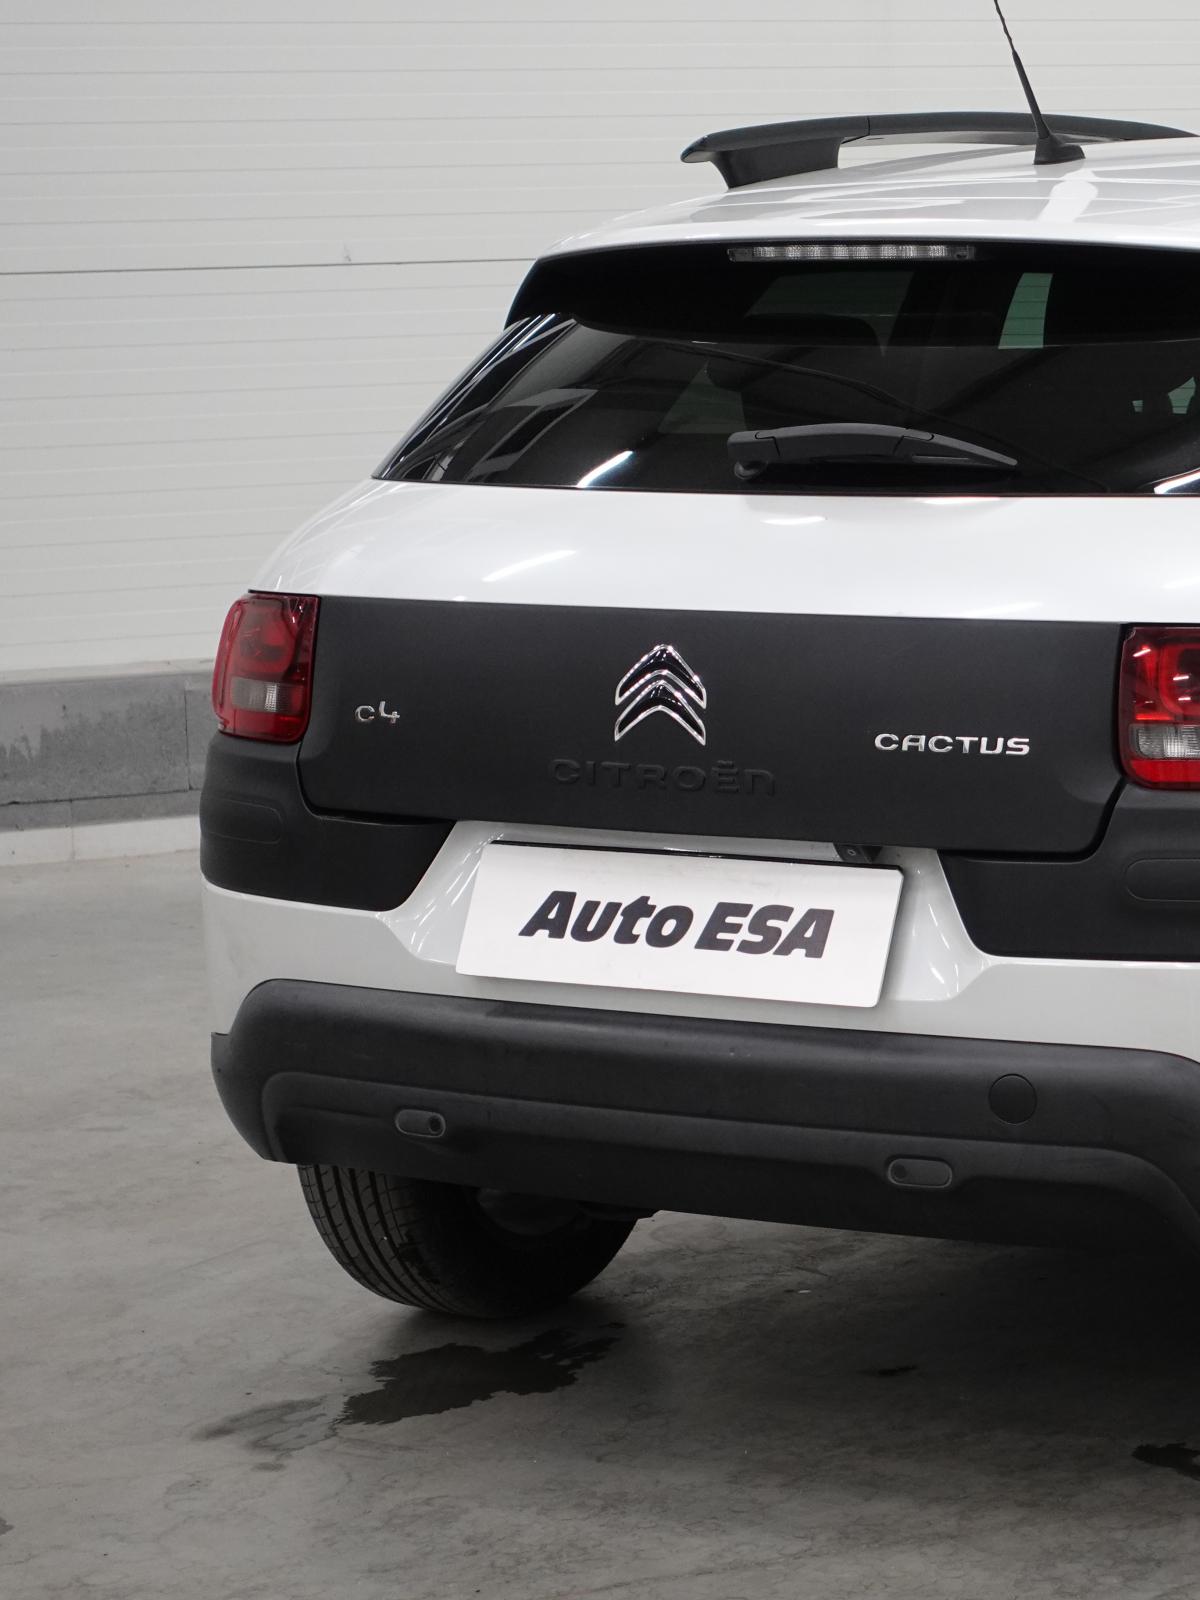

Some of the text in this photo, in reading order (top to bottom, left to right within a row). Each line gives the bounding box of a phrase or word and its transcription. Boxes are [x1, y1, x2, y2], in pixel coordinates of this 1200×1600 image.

[355, 701, 400, 724] C4
[874, 733, 1030, 756] CACTUS
[551, 759, 776, 795] CITROËN
[518, 890, 835, 959] Auto ESA
